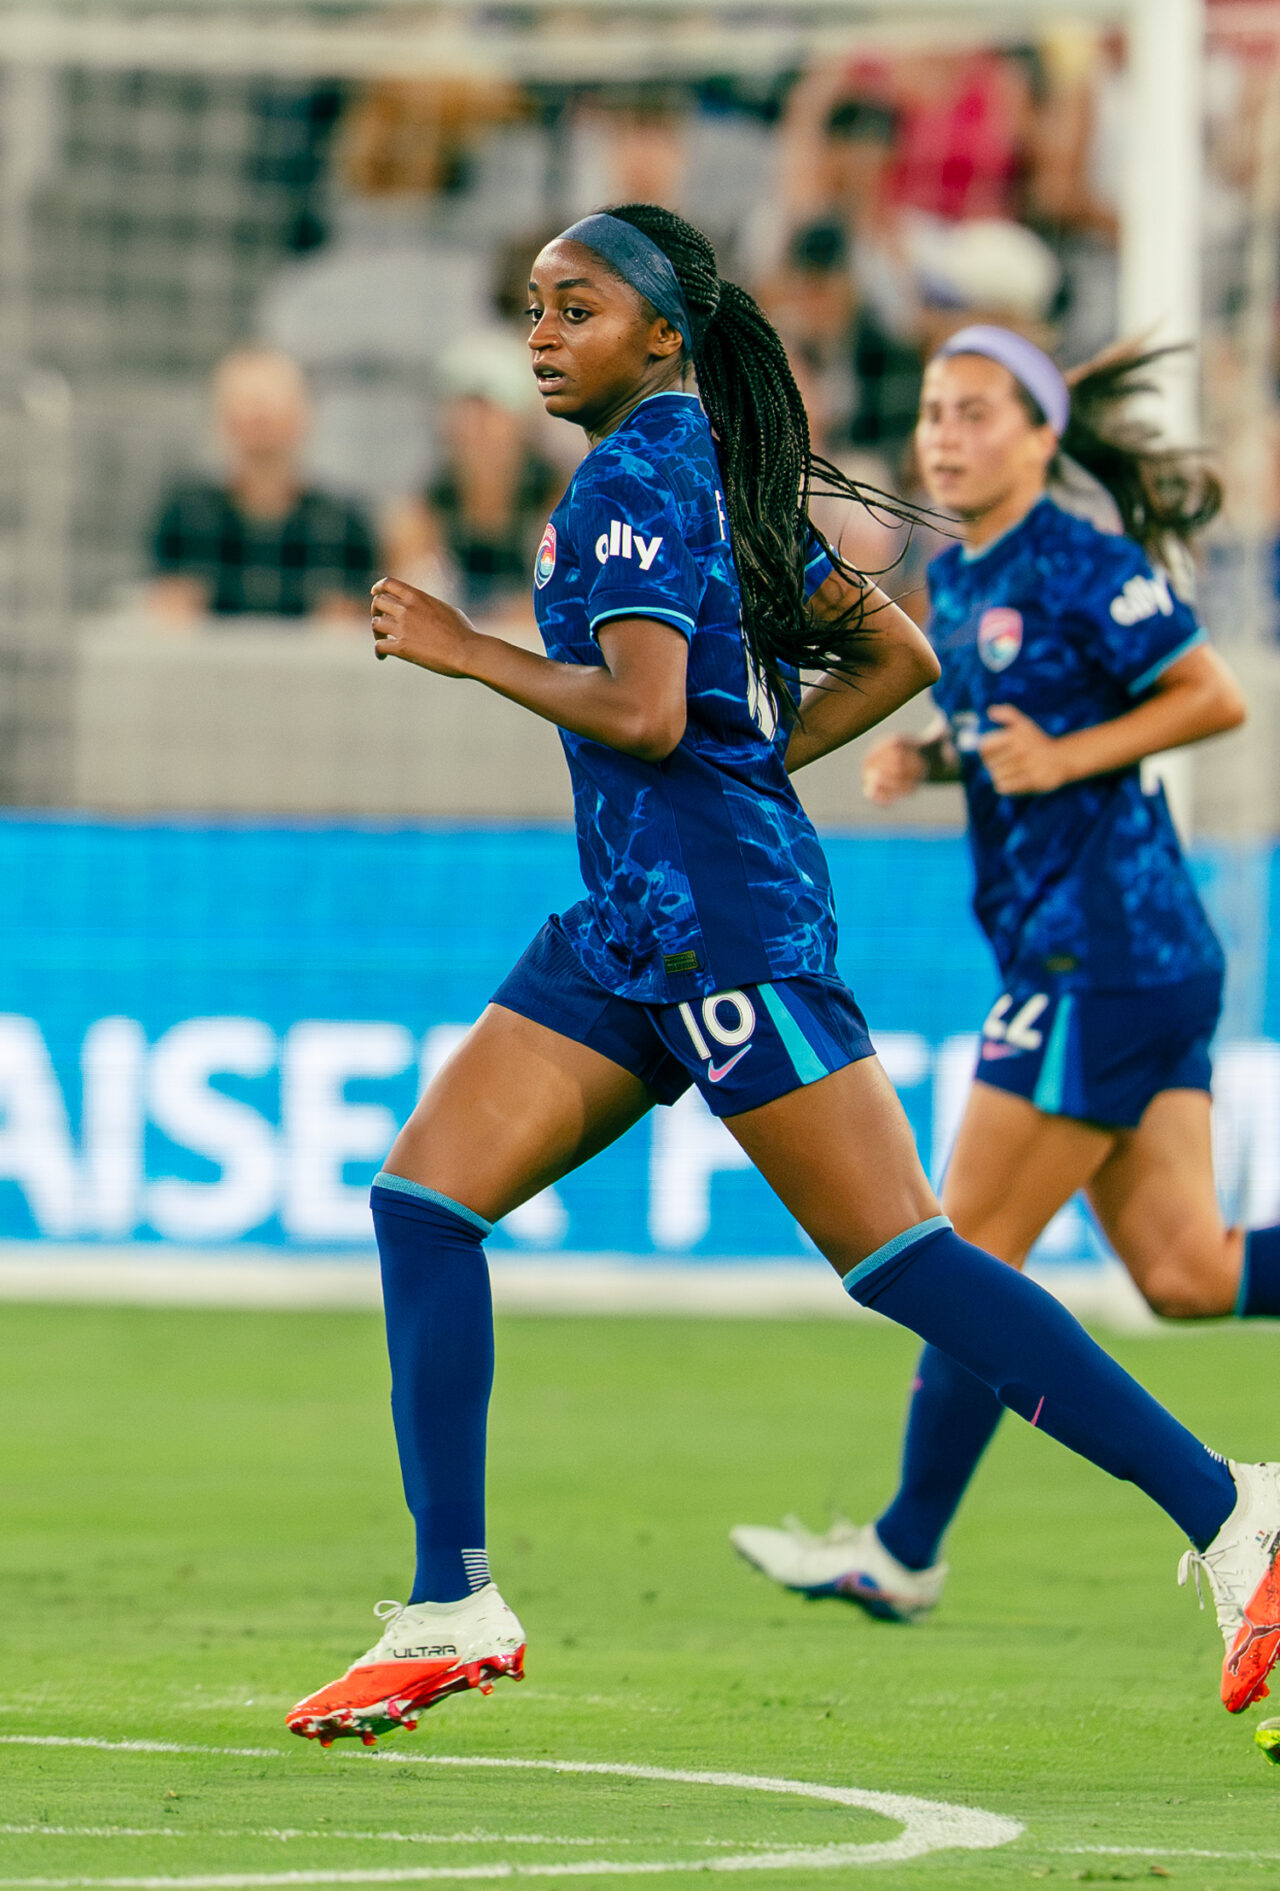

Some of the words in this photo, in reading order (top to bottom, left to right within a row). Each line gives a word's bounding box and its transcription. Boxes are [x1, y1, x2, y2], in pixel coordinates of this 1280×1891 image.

[595, 520, 664, 571] ally
[678, 989, 756, 1060] 10
[0, 1010, 568, 1248] AISE
[393, 1644, 457, 1659] ULTRA
